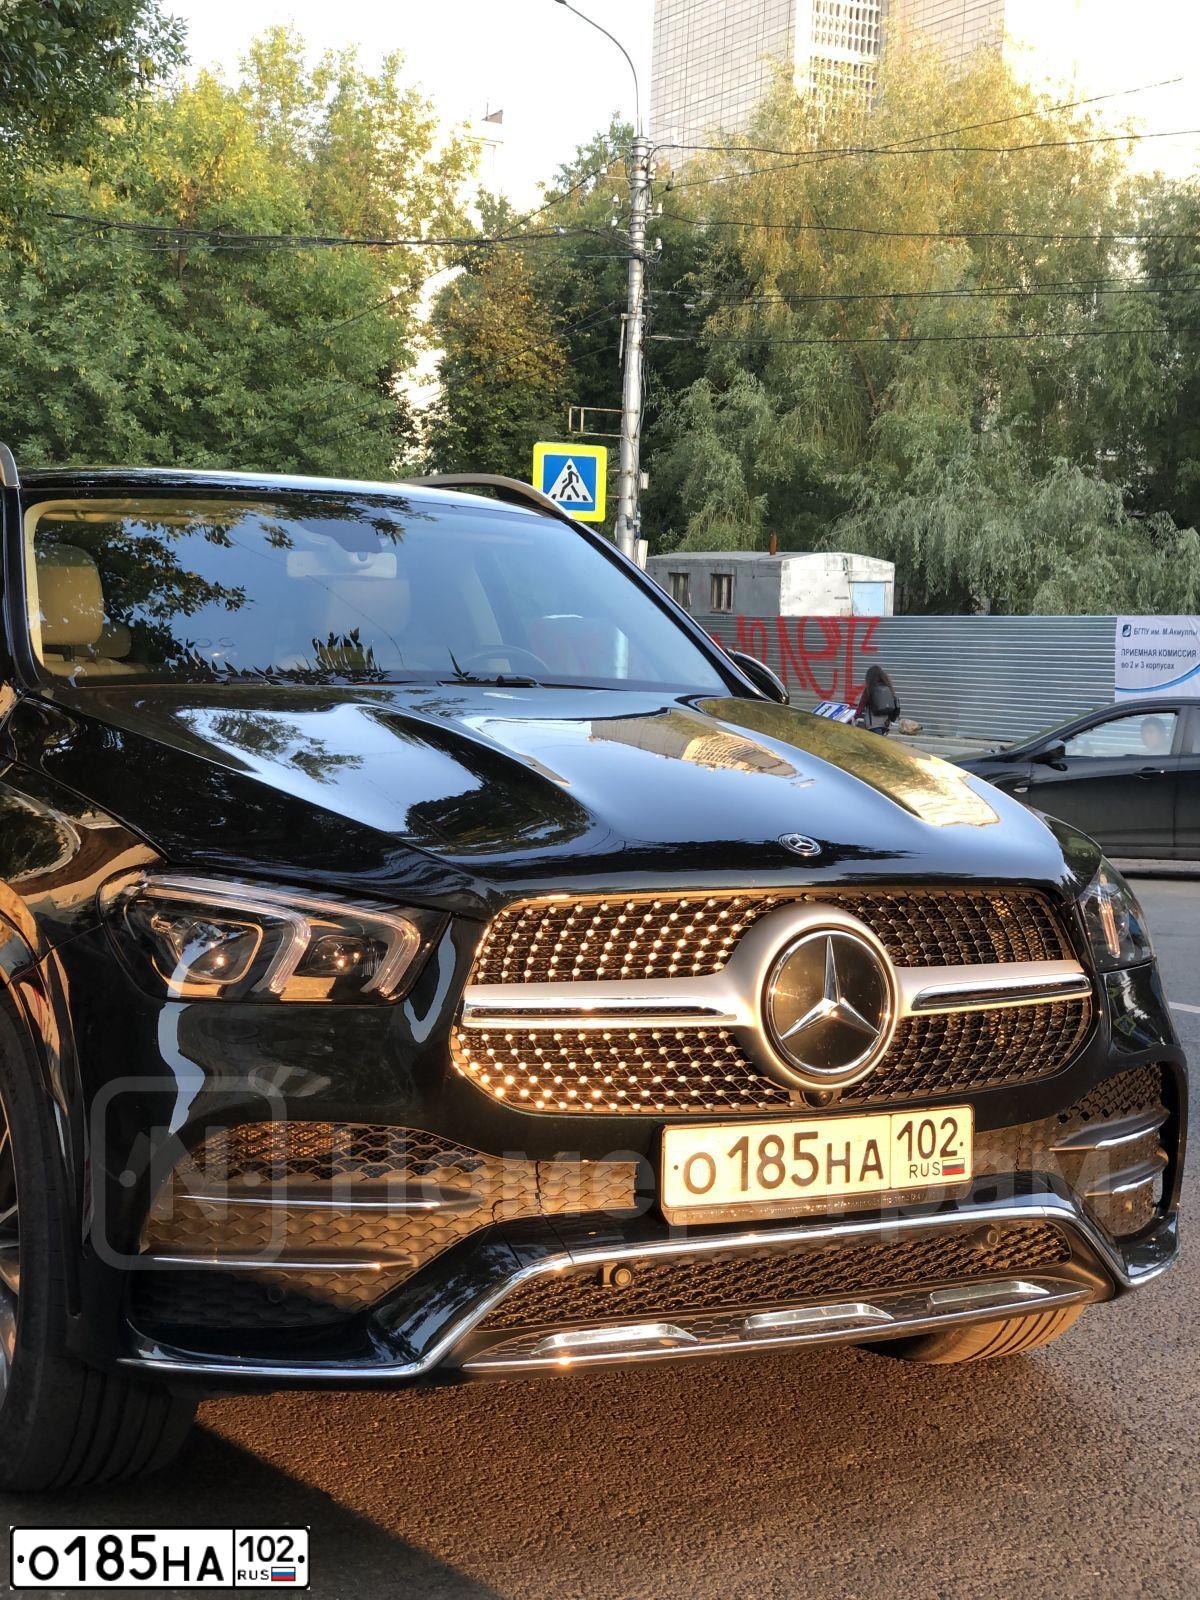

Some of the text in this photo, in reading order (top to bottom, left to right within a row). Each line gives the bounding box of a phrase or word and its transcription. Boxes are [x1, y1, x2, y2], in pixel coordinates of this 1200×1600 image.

[1121, 649, 1197, 658] ПРИЕМНАЯ КОМИССИЯ
[1130, 661, 1134, 669] 2
[1140, 661, 1145, 669] 3
[1146, 662, 1175, 670] корпусах
[896, 1116, 959, 1162] 102
[908, 1160, 941, 1179] RUS
